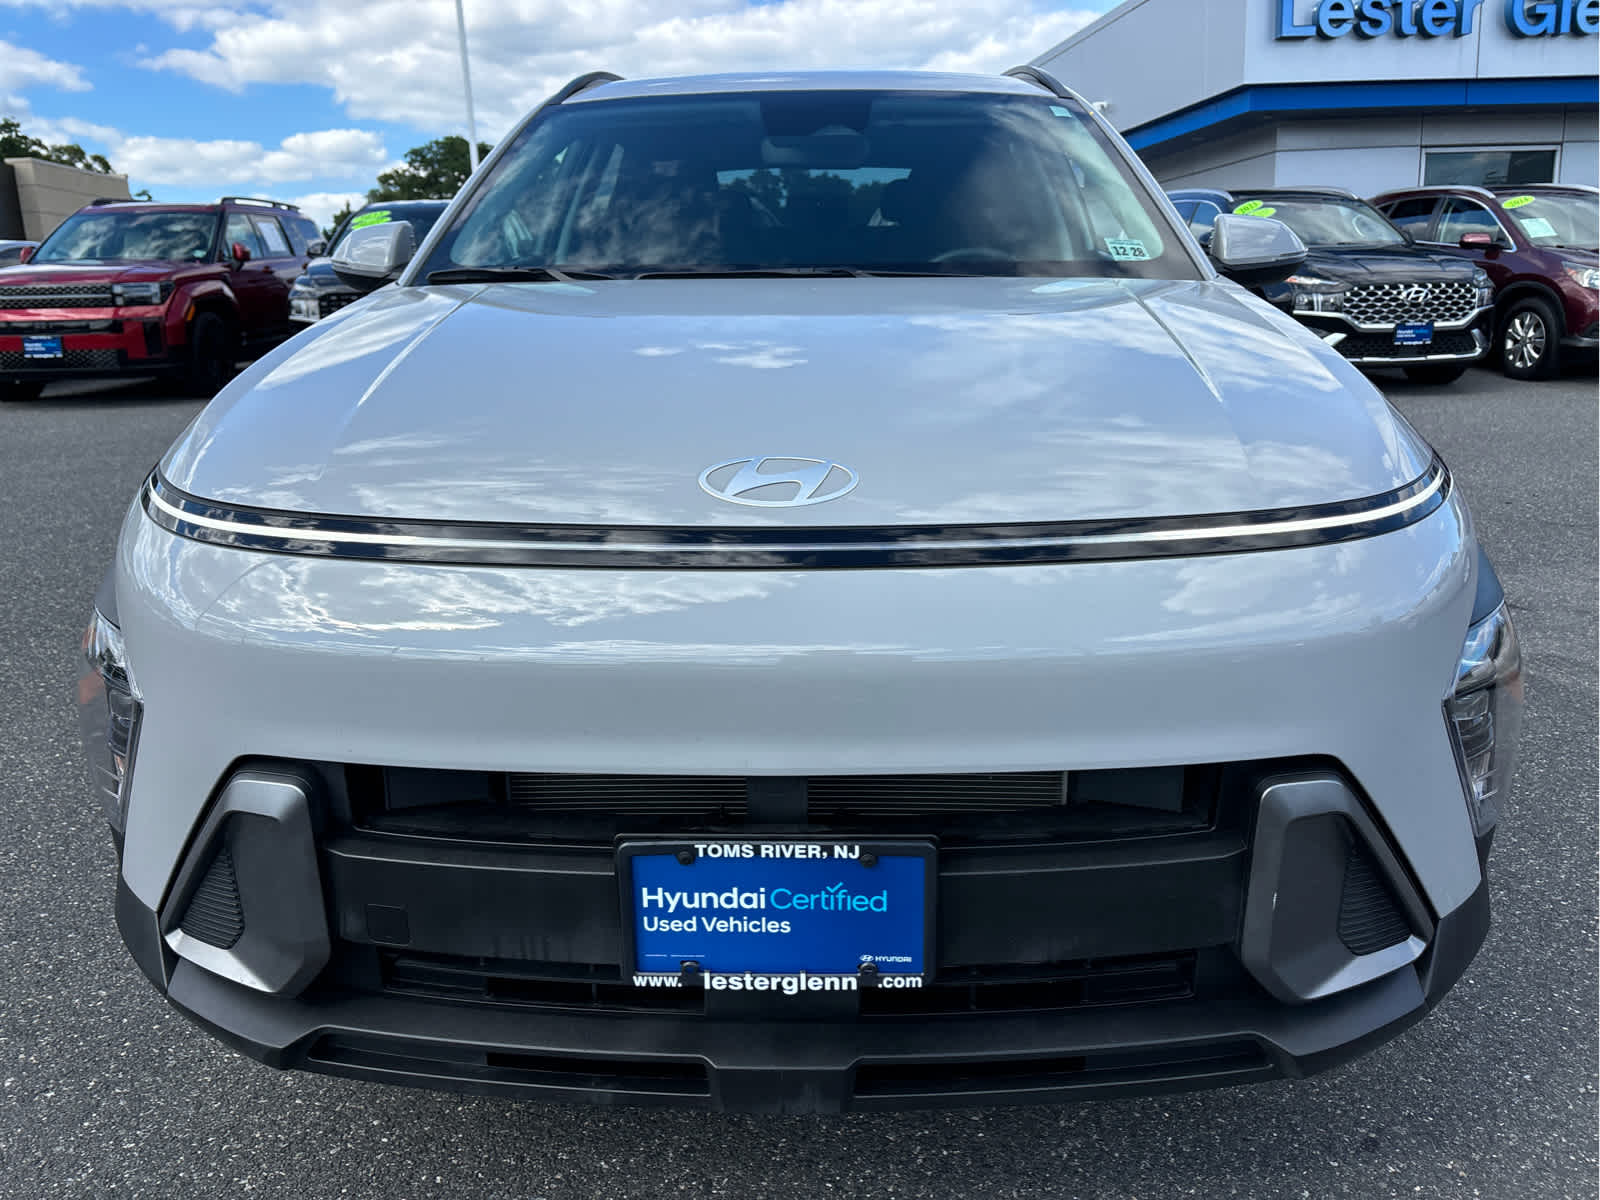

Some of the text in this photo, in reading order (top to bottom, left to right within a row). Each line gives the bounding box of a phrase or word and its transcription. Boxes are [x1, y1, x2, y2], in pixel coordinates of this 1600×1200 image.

[1275, 0, 1483, 40] Lester
[1112, 246, 1129, 256] 12
[694, 844, 860, 860] TOMS RIVER, NJ
[641, 882, 888, 913] Hyundai Certified
[643, 916, 792, 933] Used Vehicles
[874, 955, 912, 963] HYUNDAI
[632, 975, 682, 987] www.
[704, 972, 858, 995] lesterglenn
